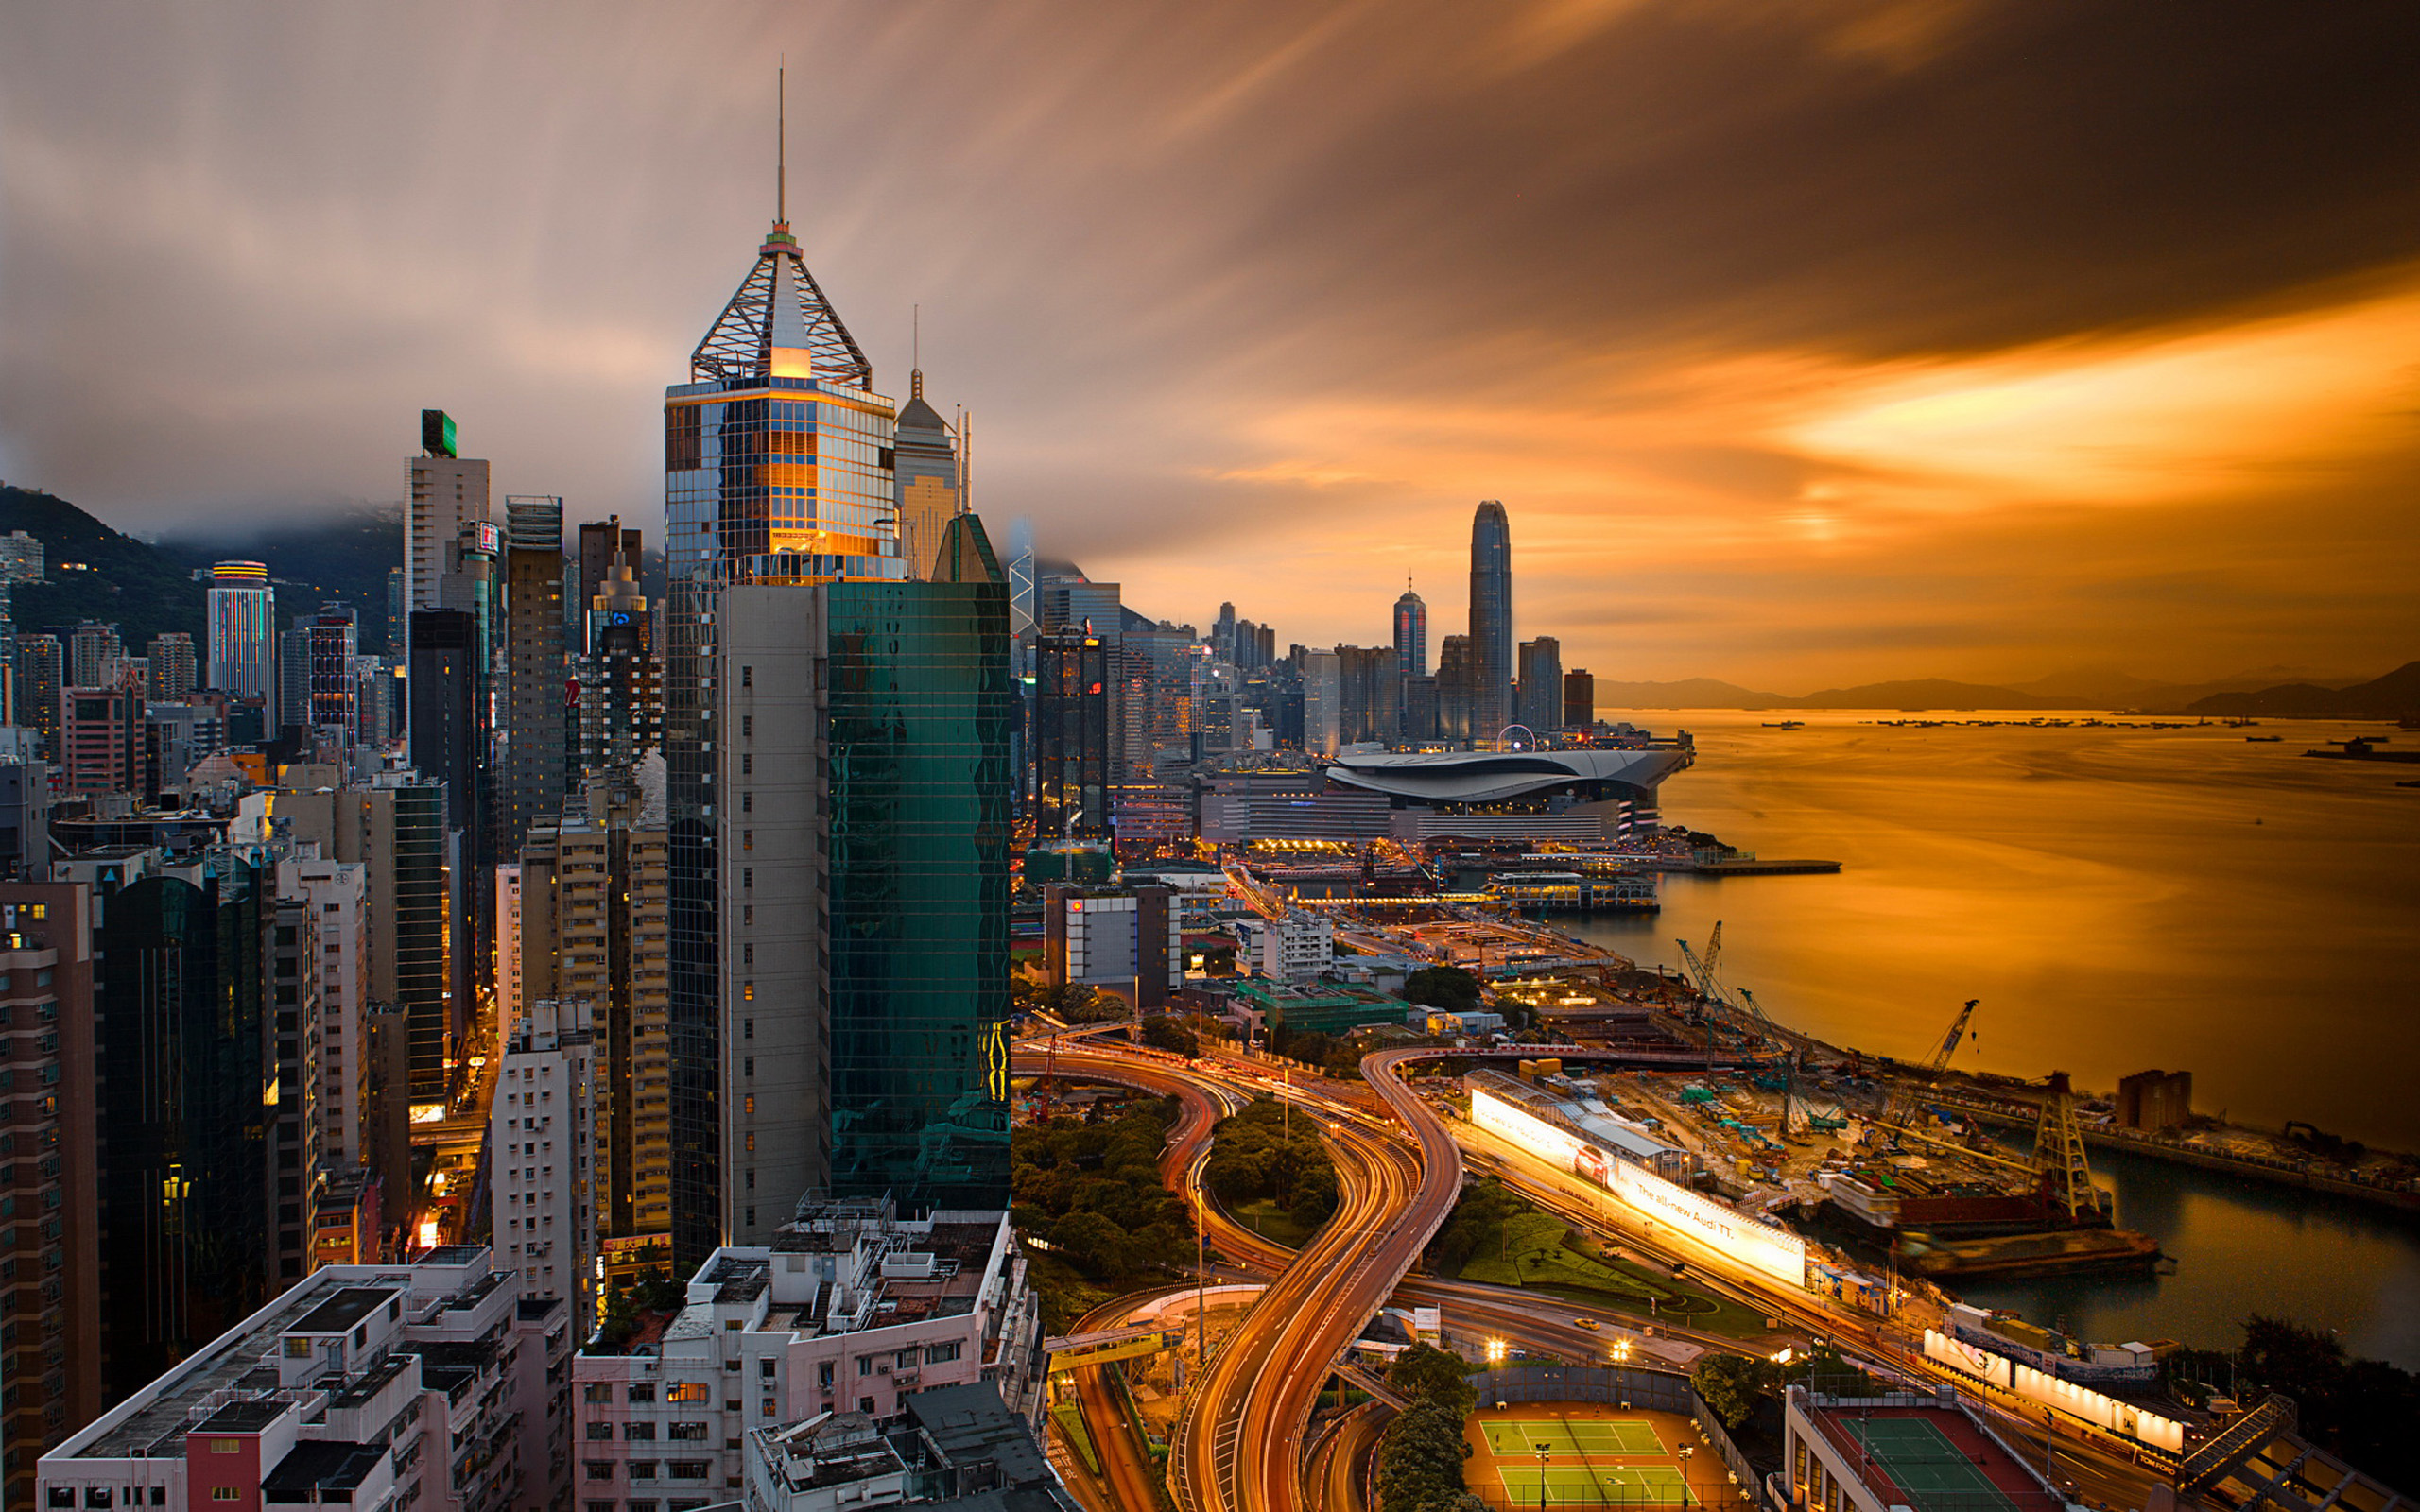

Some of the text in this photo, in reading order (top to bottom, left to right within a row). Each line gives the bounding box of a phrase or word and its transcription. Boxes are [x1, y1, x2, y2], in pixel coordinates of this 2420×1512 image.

[1637, 1183, 1735, 1240] The all-new Audi TT.
[2139, 1454, 2176, 1475] TOM FORD
